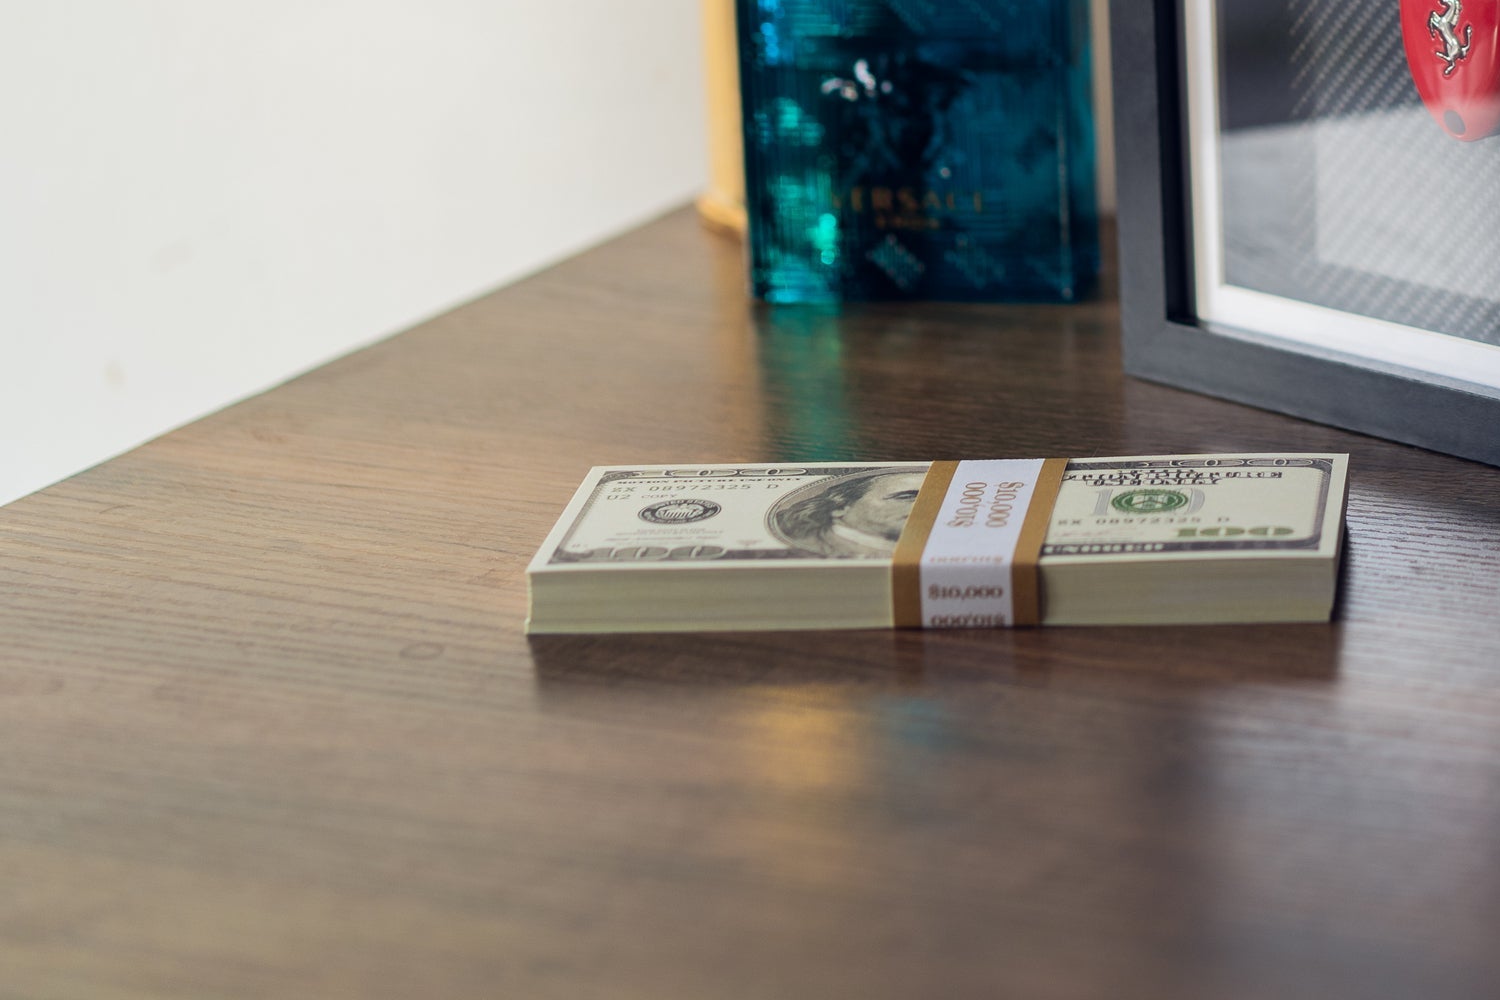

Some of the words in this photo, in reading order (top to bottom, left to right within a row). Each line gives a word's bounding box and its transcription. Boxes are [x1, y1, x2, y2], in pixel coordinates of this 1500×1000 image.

[948, 481, 987, 528] $10,000
[985, 481, 1025, 528] $10,000
[1176, 527, 1295, 538] 100
[928, 583, 1004, 600] $10,000
